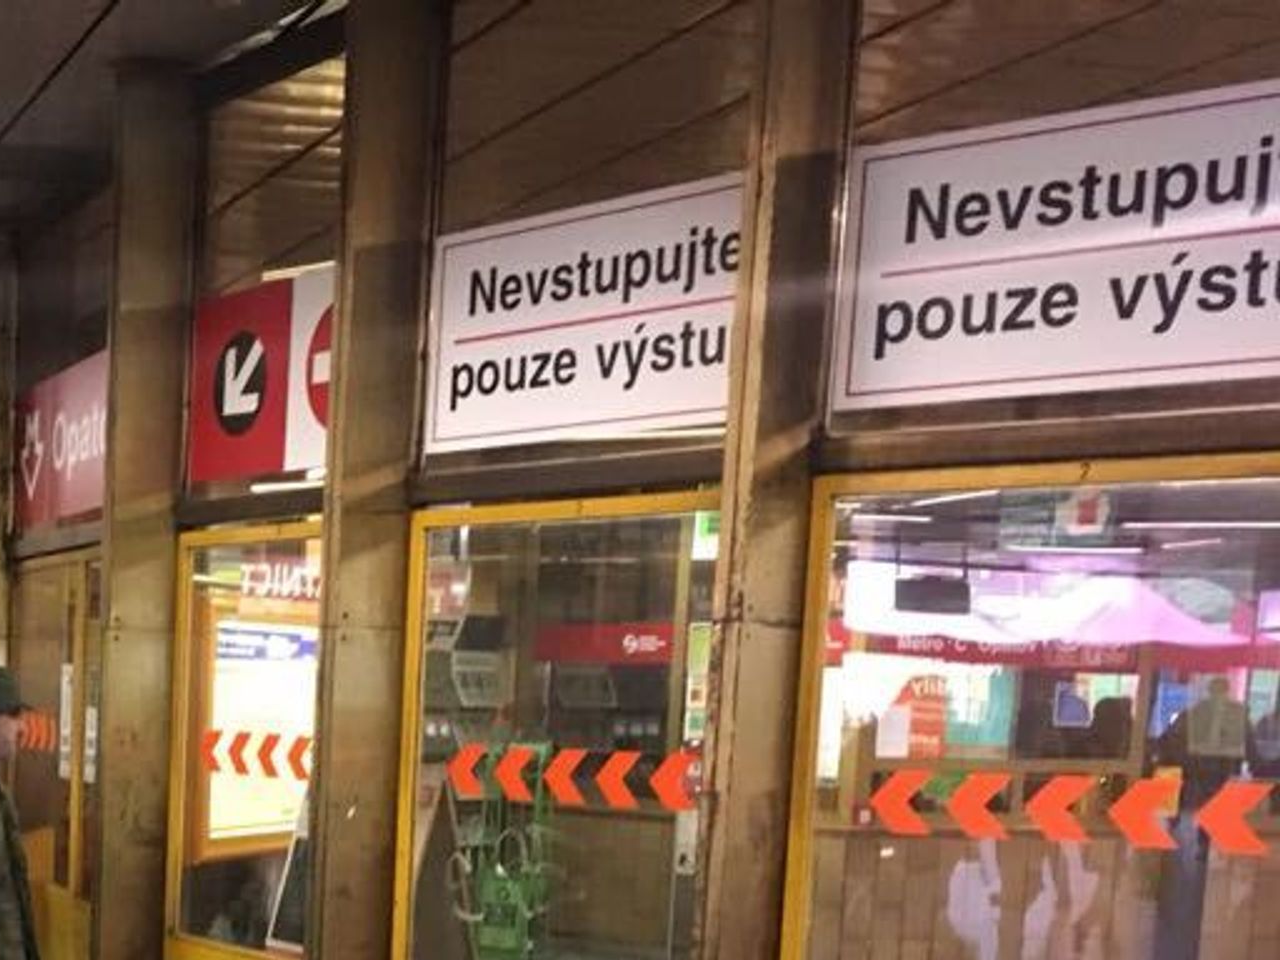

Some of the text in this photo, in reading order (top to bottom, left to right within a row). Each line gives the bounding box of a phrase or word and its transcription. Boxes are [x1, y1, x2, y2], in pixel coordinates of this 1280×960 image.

[904, 135, 1280, 244] Nevstupuj
[468, 225, 741, 317] Nevstupujte
[874, 281, 1079, 360] pouze
[449, 322, 726, 412] pouze výstu
